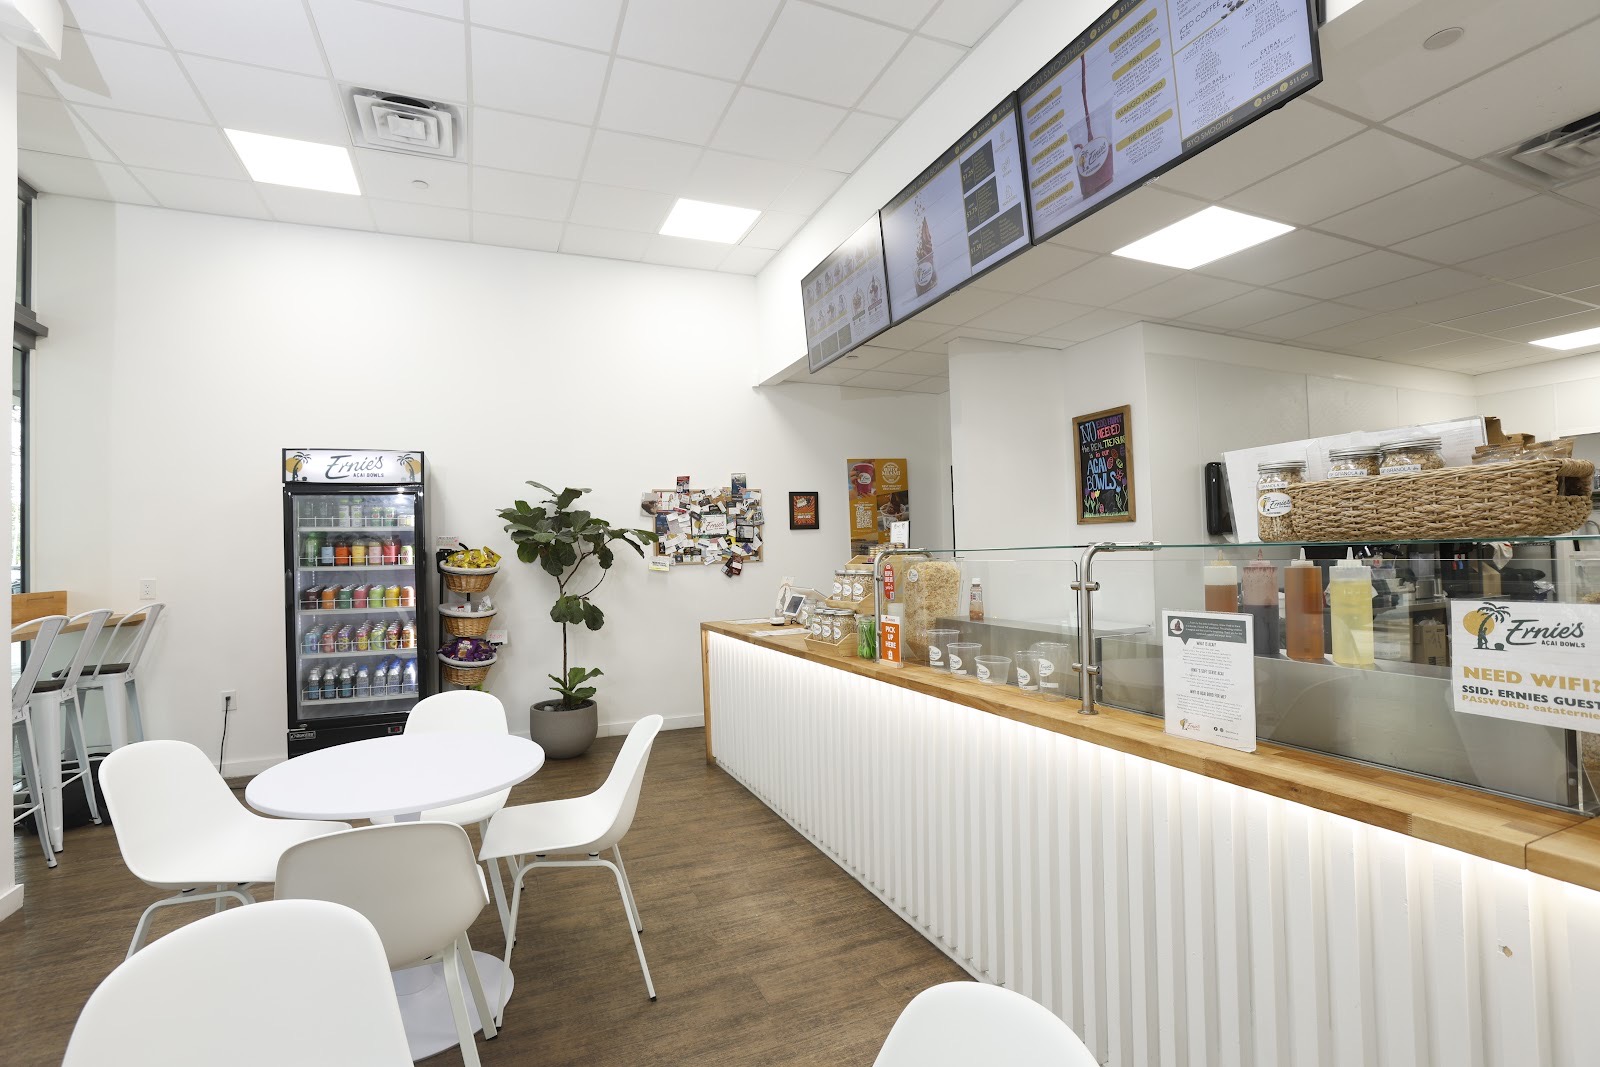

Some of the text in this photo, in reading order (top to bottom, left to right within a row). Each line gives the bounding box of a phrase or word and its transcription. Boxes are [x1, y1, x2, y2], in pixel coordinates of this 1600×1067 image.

[1179, 19, 1194, 34] ICED
[1195, 0, 1220, 22] COFFEE
[1260, 38, 1280, 54] EXTRAS
[1043, 36, 1085, 81] SMOOTHIES
[1263, 89, 1278, 101] $8.50
[1290, 71, 1308, 86] $11.00
[1118, 96, 1140, 117] MANGO
[1141, 80, 1162, 101] TANGO
[1186, 135, 1199, 147] BYO
[1200, 115, 1234, 139] SMOOTHIE
[1080, 421, 1097, 443] NO
[1097, 424, 1120, 439] NEEDED
[1090, 442, 1104, 452] REAL
[324, 454, 384, 480] Ernie's
[1086, 470, 1117, 490] BOWLS
[885, 626, 896, 634] PICK
[1506, 619, 1584, 646] Ernie's
[1463, 666, 1522, 684] NEED
[1462, 685, 1600, 710] SSID: ERNIES GUEST
[1462, 694, 1530, 710] PASSWORD:
